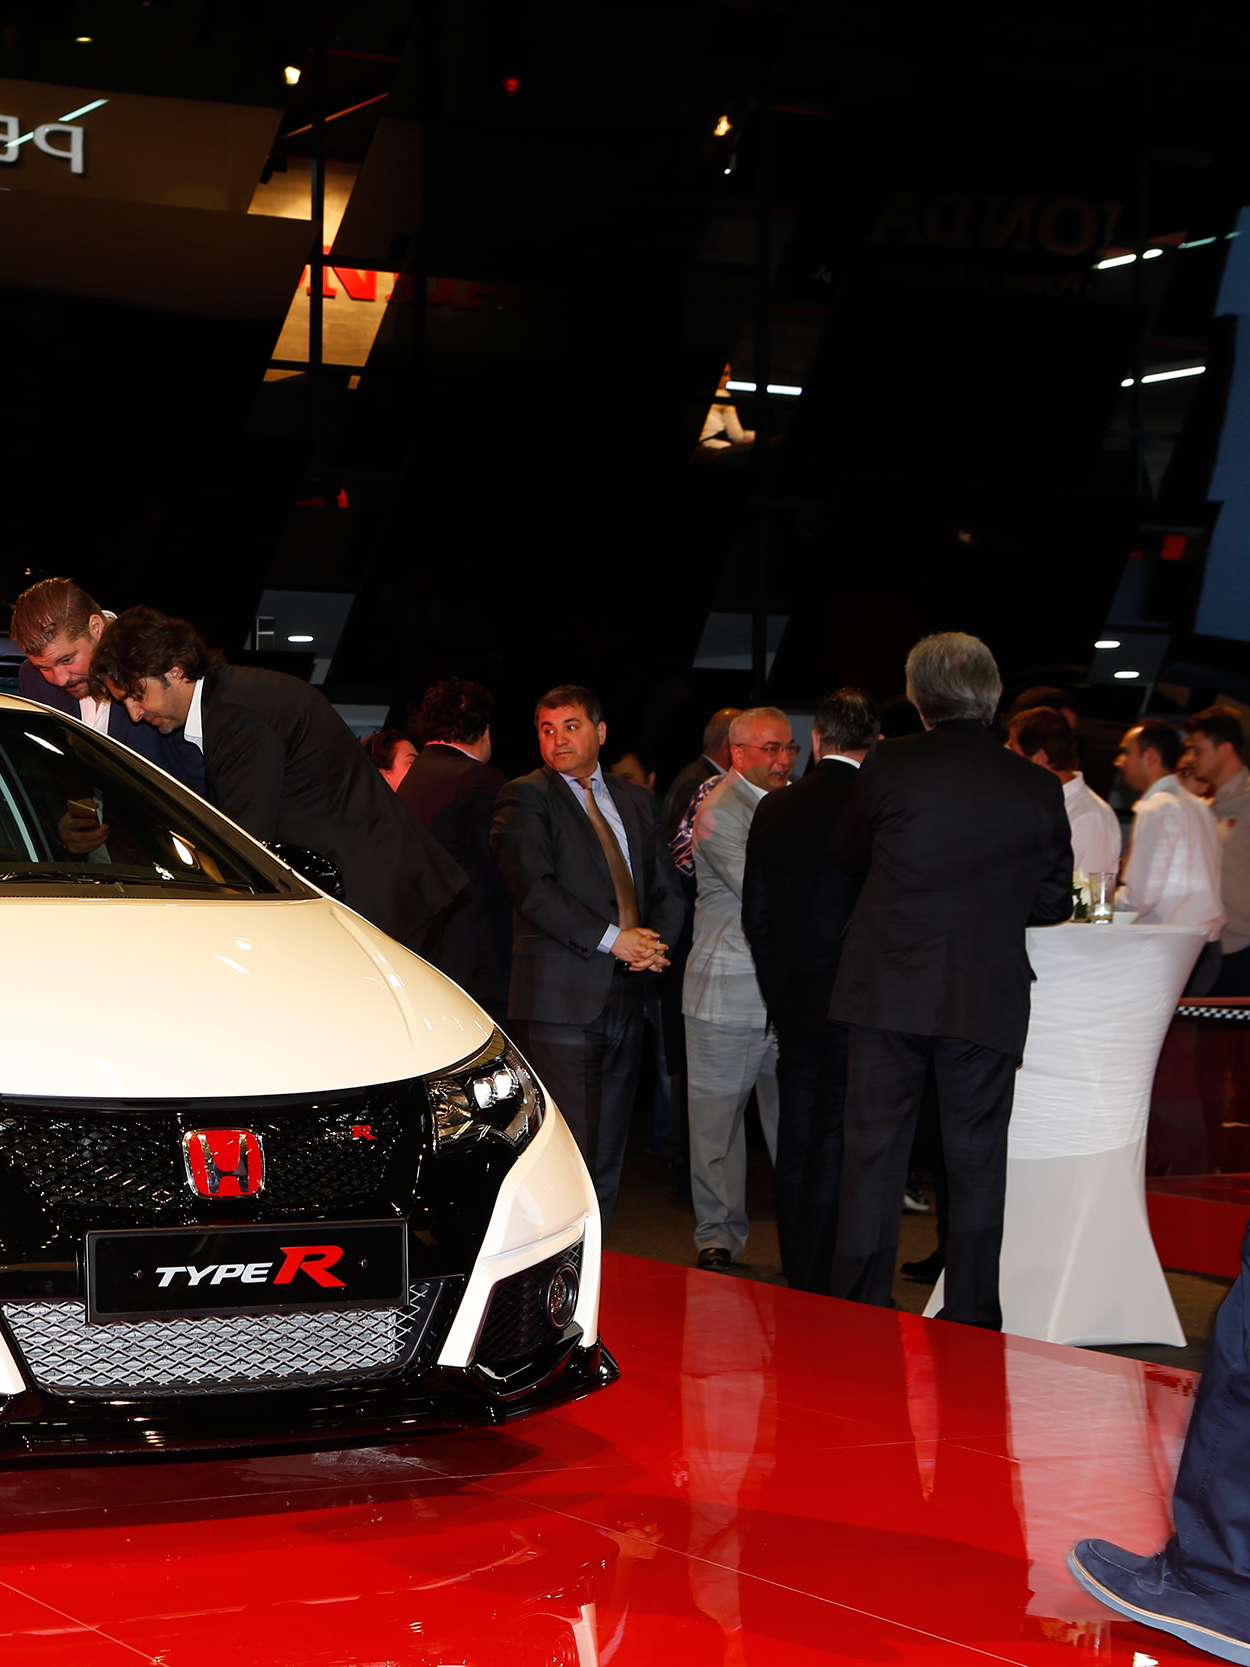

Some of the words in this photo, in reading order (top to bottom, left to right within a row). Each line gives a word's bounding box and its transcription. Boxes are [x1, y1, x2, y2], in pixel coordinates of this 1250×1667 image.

[350, 1125, 378, 1140] R
[155, 1262, 274, 1288] TYPE
[273, 1245, 347, 1288] R
